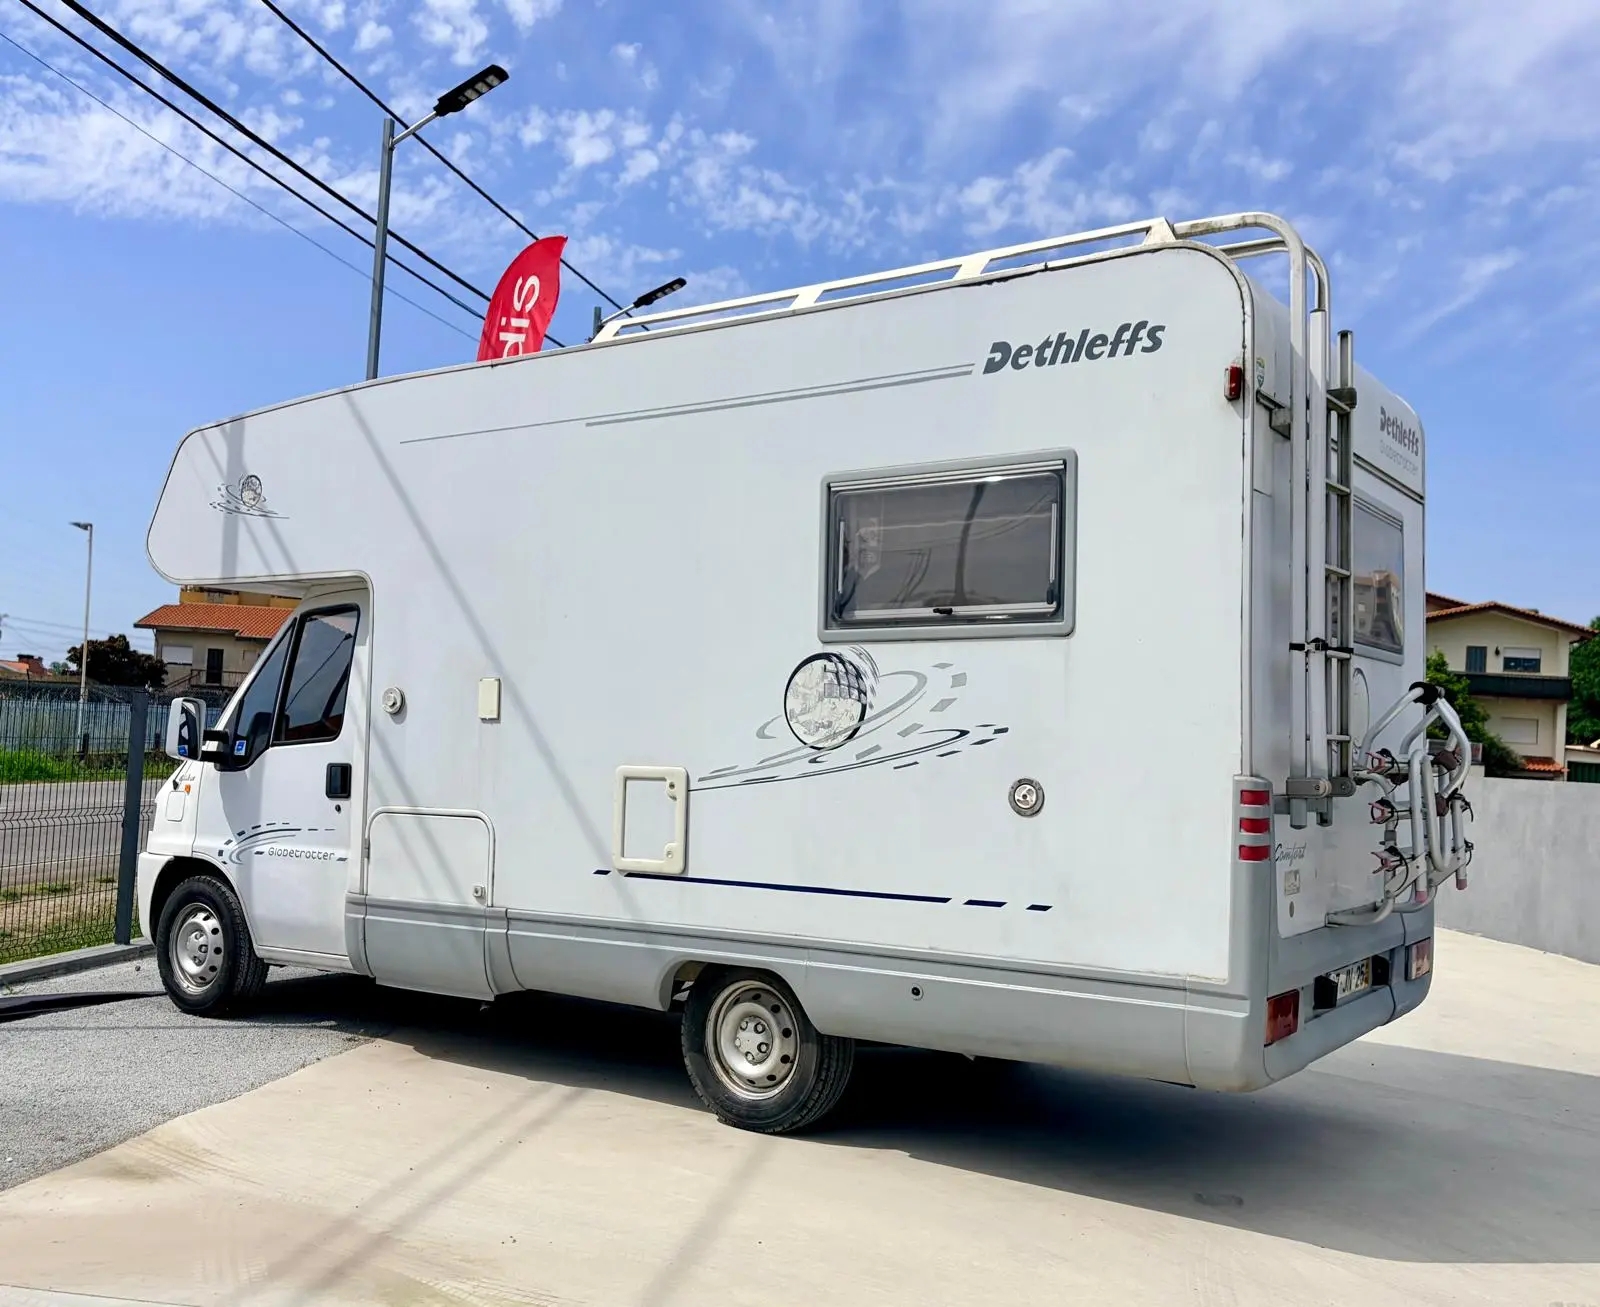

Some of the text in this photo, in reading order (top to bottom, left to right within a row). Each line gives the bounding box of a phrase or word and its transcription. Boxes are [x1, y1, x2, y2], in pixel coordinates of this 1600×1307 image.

[983, 320, 1166, 375] Dethleffs
[1380, 406, 1419, 456] Dethleffs
[267, 847, 335, 860] Globetrotter
[1274, 843, 1307, 866] Comfort
